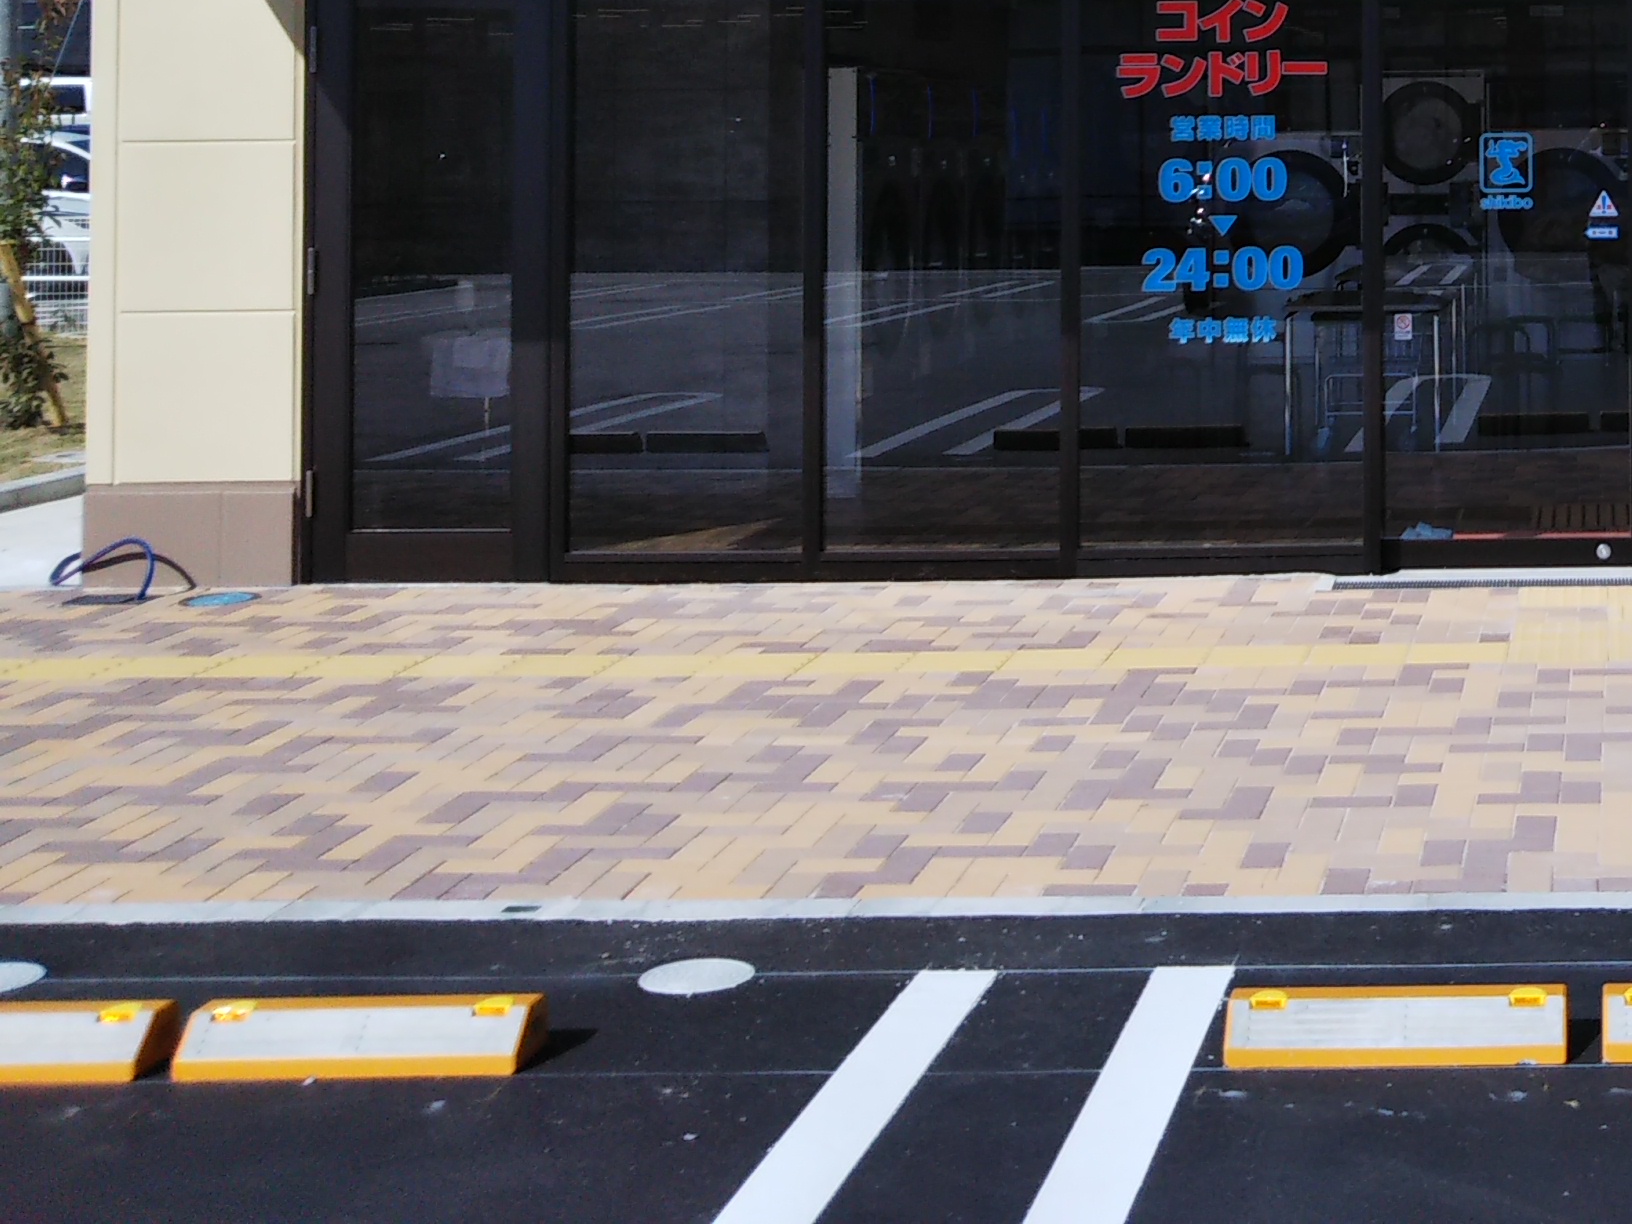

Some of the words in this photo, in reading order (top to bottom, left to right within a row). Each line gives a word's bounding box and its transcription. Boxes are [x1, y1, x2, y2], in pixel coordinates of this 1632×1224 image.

[1116, 49, 1329, 99] ランドリー
[1169, 114, 1277, 142] 営業時間
[1157, 156, 1288, 203] 6:00
[1479, 194, 1534, 210] shikibo
[1141, 245, 1304, 293] 24:00
[1168, 316, 1278, 345] 年中無休
